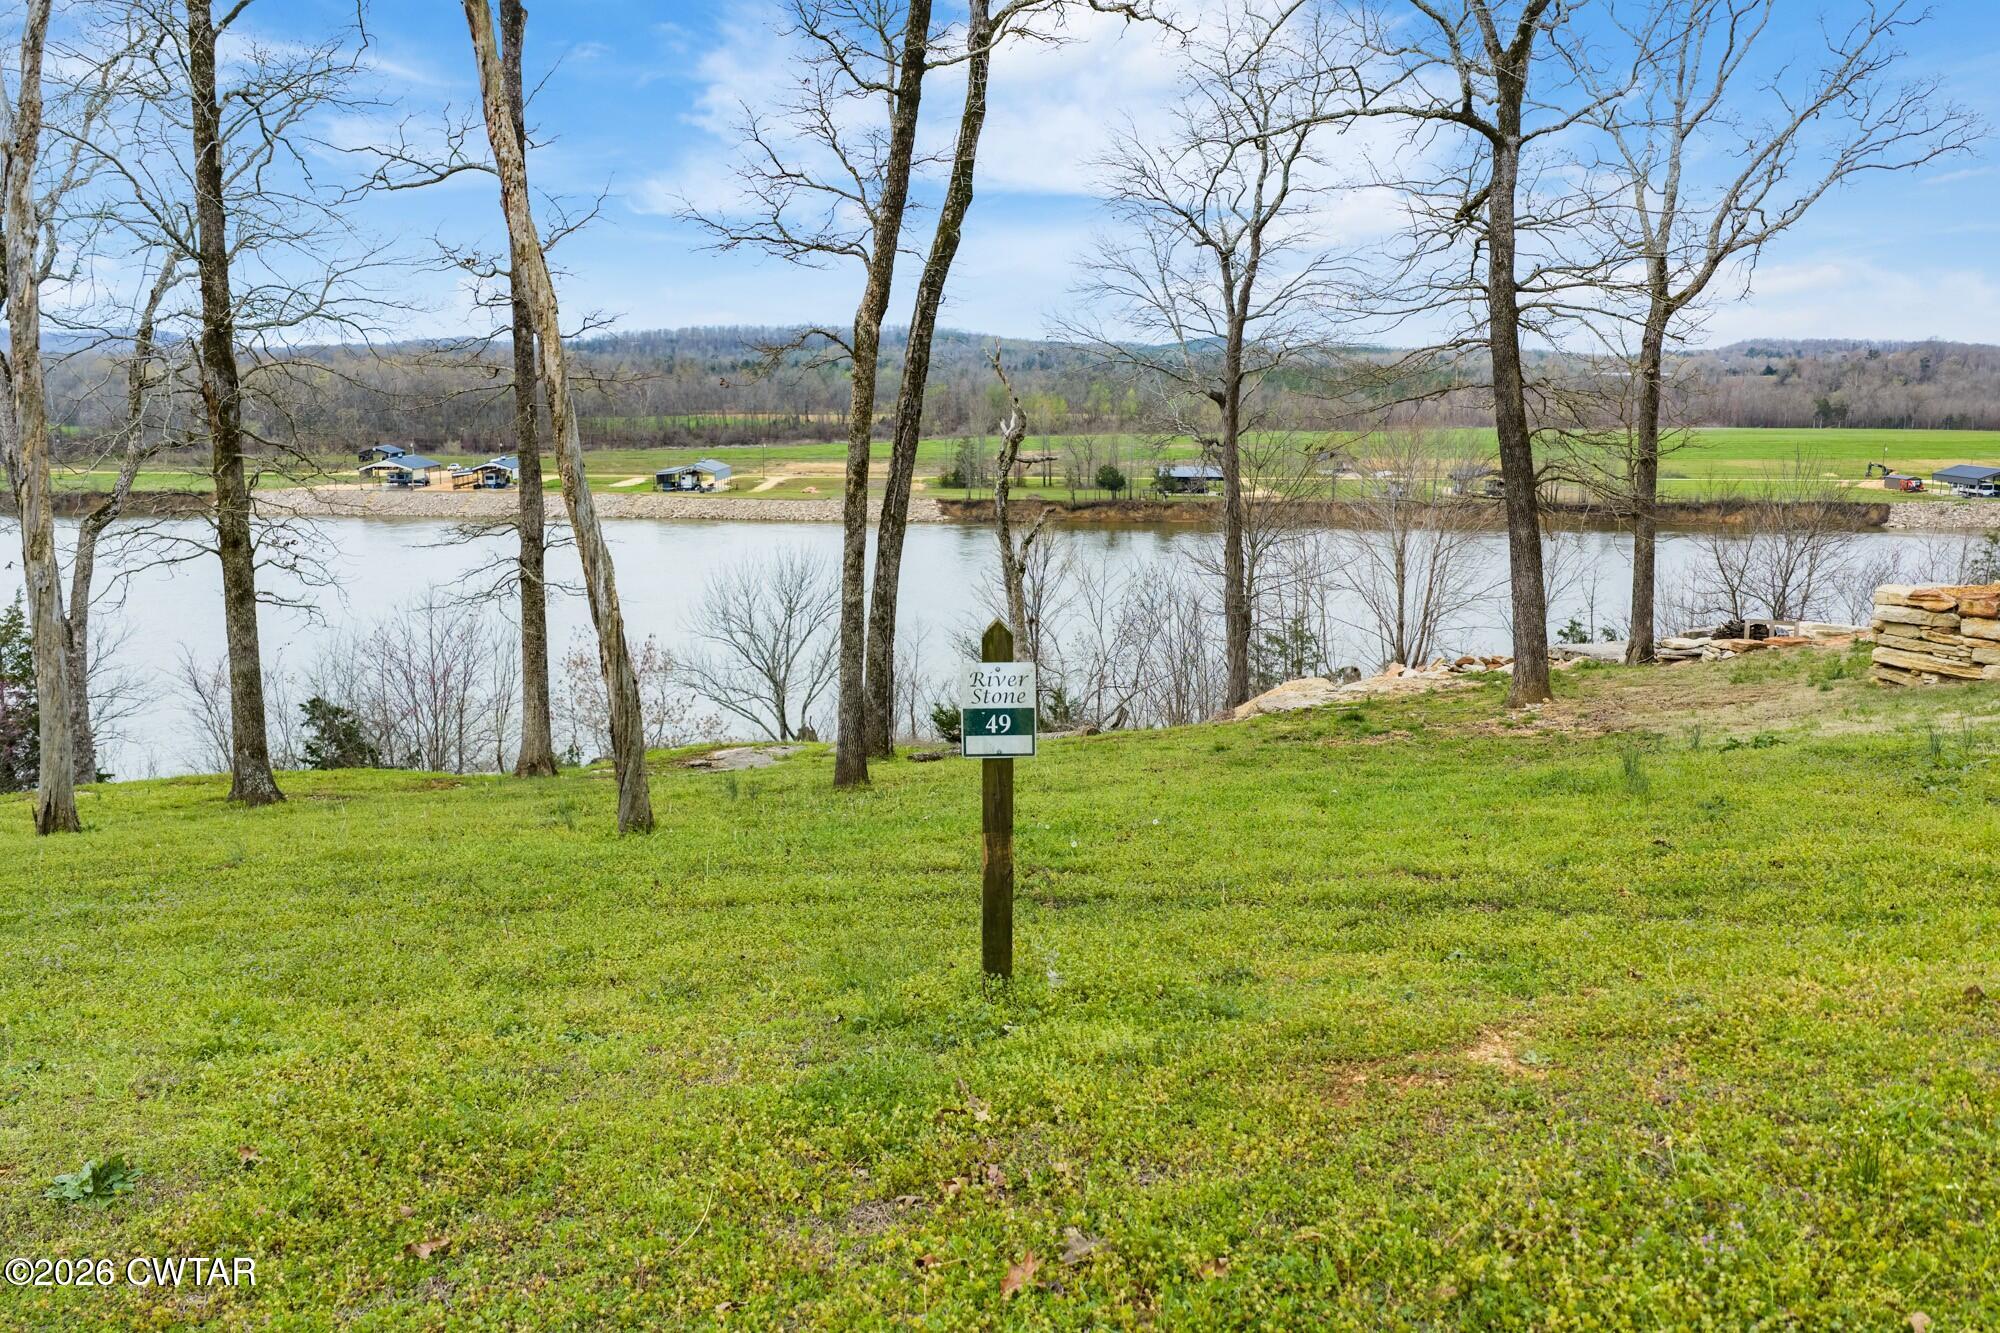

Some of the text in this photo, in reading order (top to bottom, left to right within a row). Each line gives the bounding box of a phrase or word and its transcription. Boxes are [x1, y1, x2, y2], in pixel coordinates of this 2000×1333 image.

[970, 671, 1030, 687] River
[971, 688, 1026, 705] Stone
[985, 714, 1012, 734] 49
